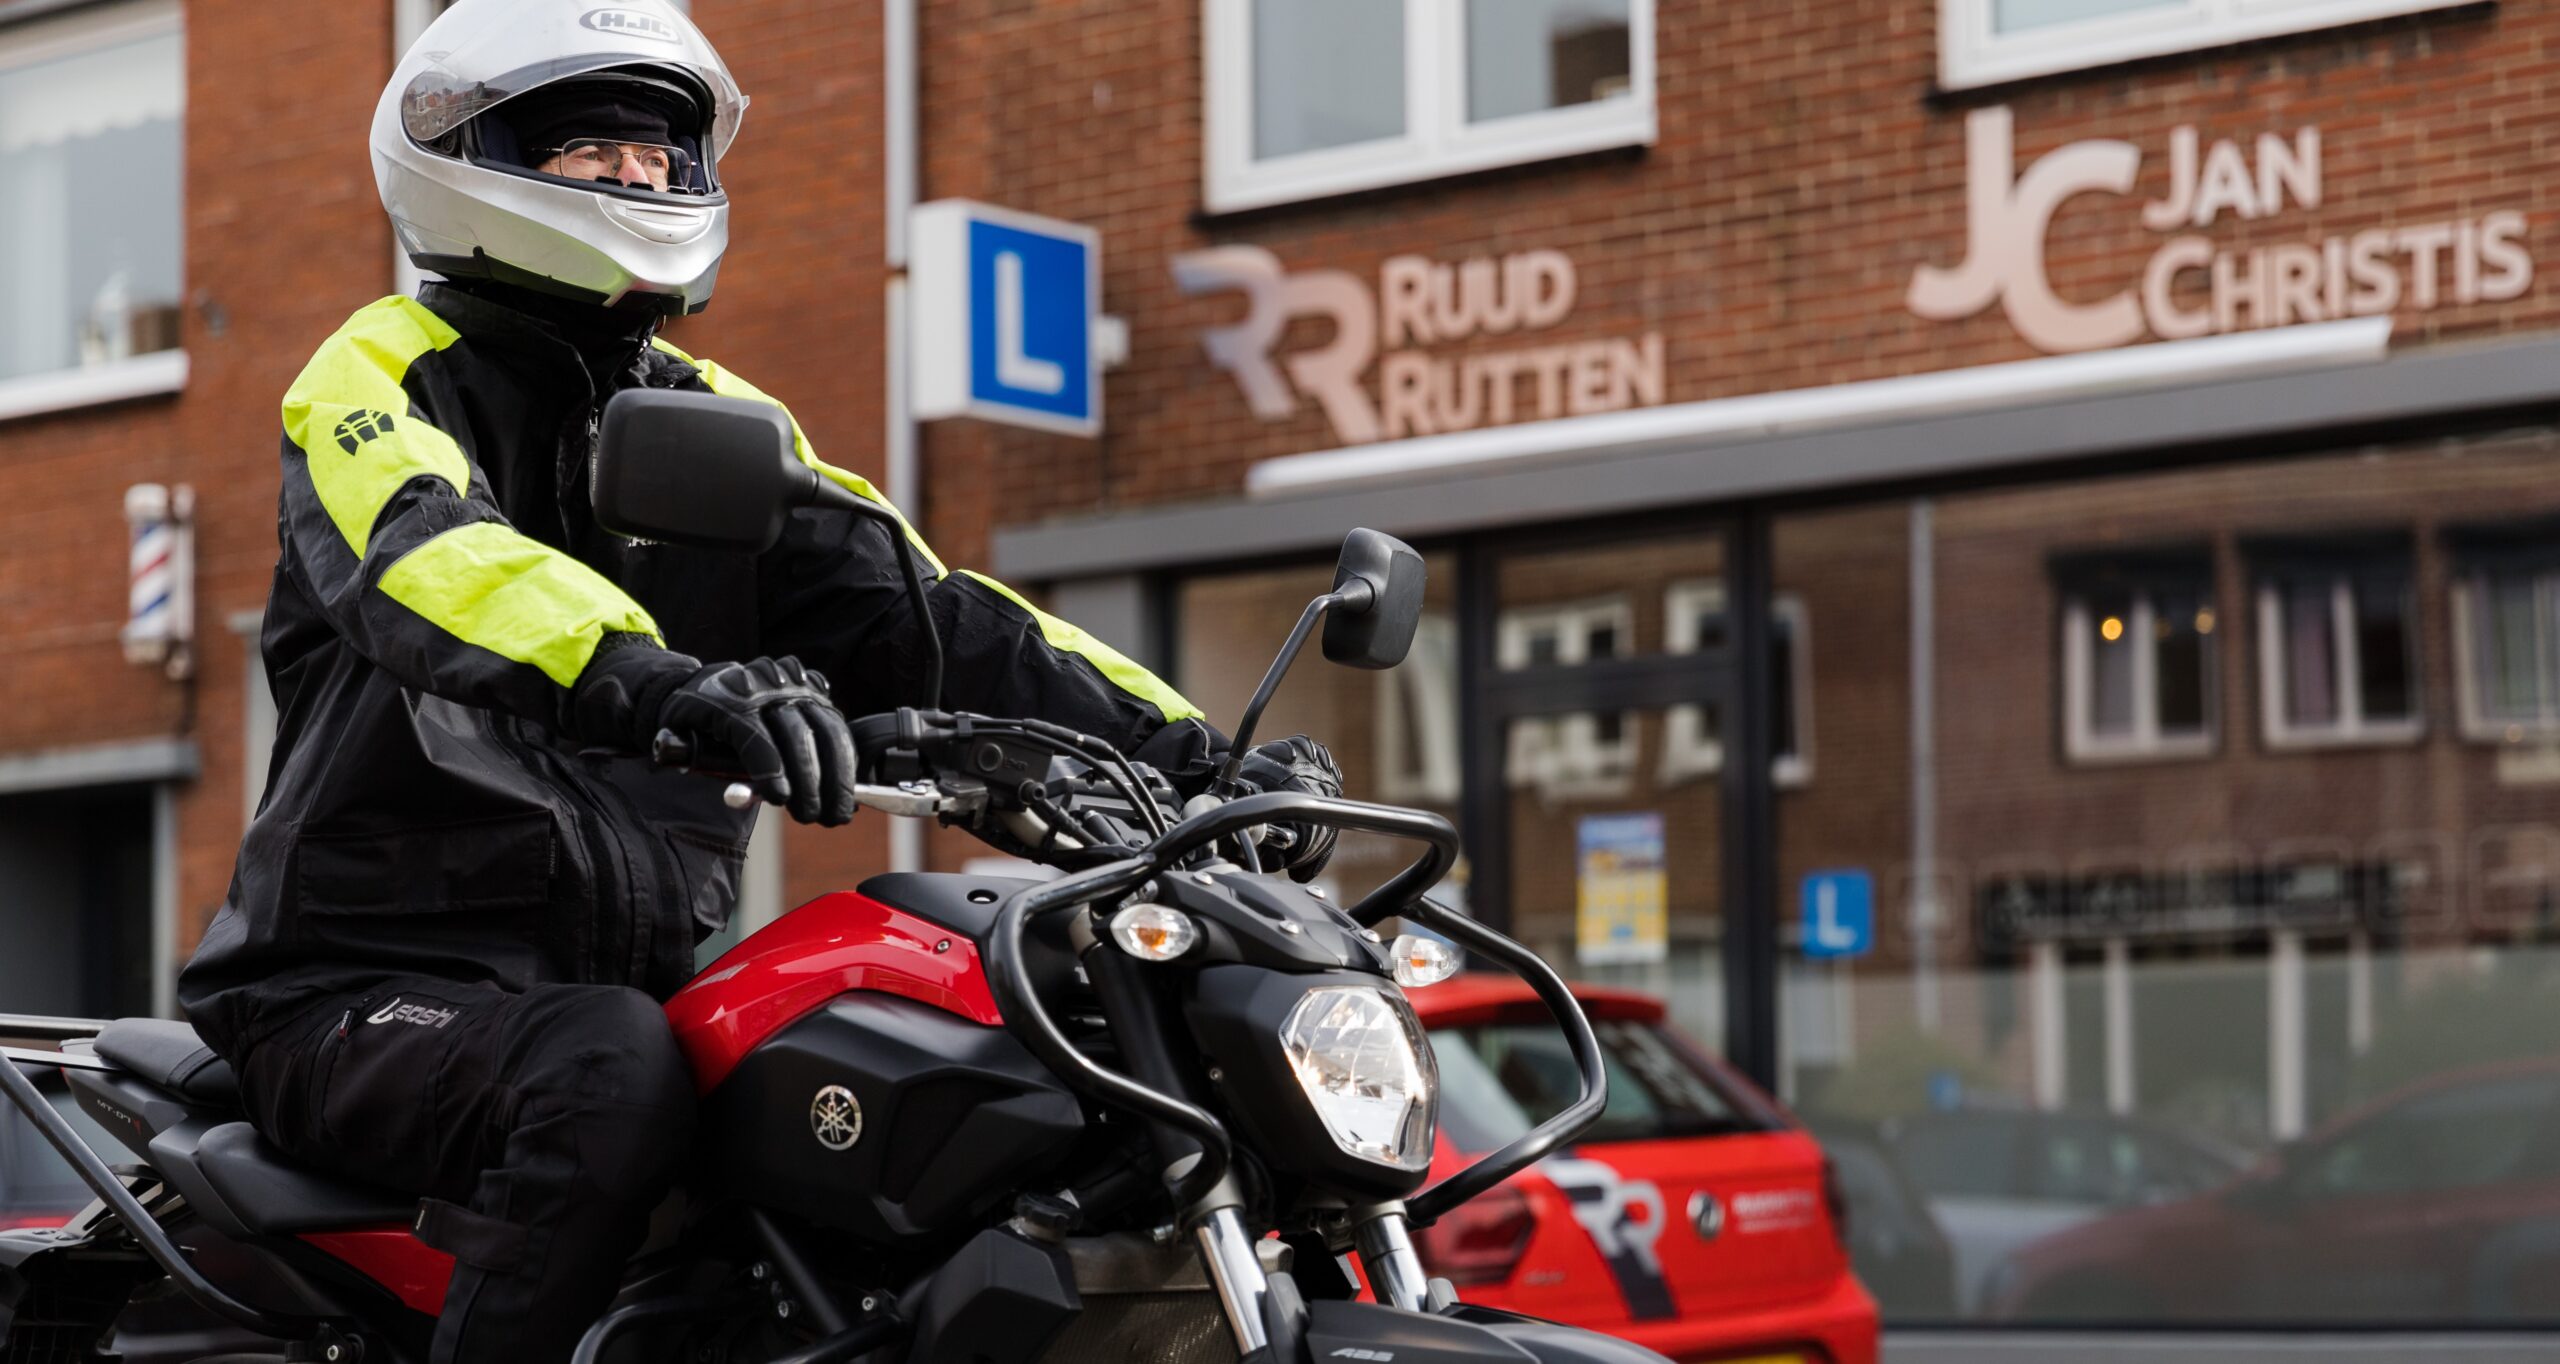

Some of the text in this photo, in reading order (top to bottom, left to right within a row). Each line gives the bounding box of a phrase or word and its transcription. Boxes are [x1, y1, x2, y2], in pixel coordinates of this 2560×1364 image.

[600, 13, 672, 37] HJC
[1906, 106, 2146, 354] JC
[994, 250, 1065, 396] L
[1172, 244, 1380, 444] RR
[1816, 878, 1858, 948] L
[97, 1099, 132, 1124] MT-07
[1329, 1347, 1395, 1363] ABS
